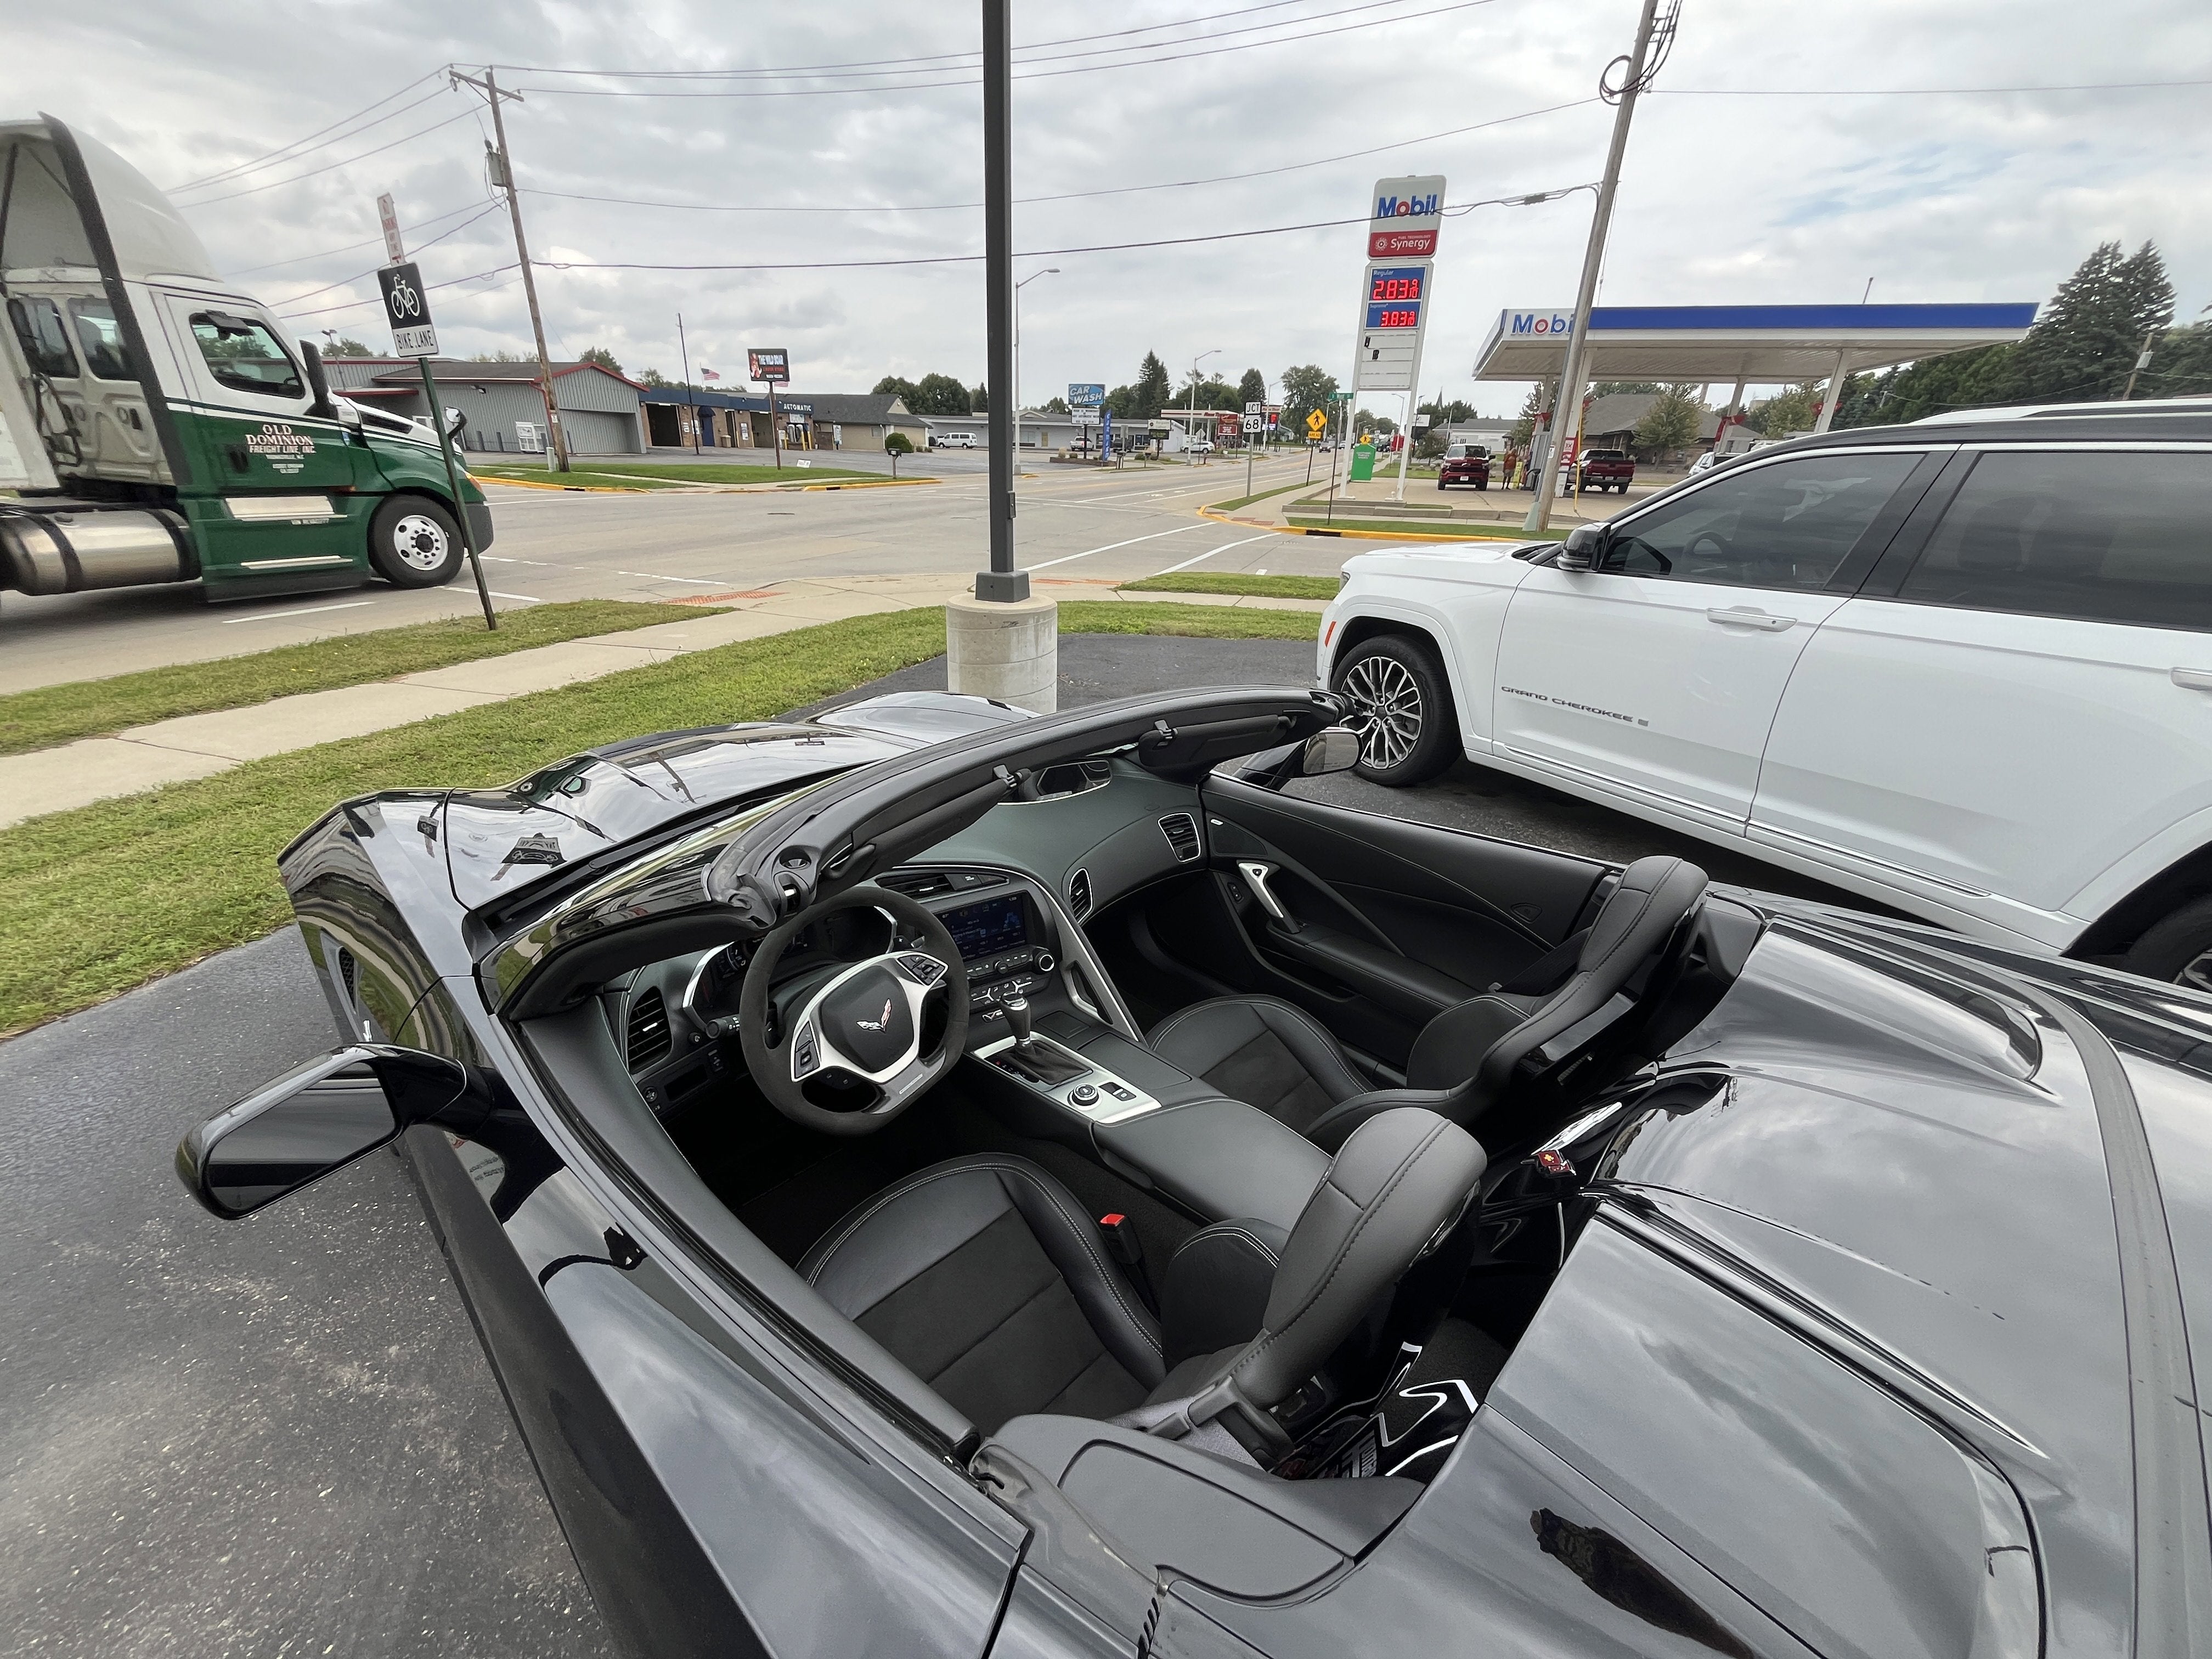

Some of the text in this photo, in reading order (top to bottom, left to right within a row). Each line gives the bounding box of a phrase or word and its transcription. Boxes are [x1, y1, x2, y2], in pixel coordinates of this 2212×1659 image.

[1378, 194, 1437, 218] Mobil
[1390, 239, 1431, 251] Synergy
[1511, 314, 1575, 334] Mobi
[396, 330, 434, 349] BIKE LANE
[1070, 386, 1091, 396] CAR
[1074, 392, 1103, 404] WASH
[783, 403, 812, 411] AUTOMATIC
[1247, 404, 1260, 413] JCT
[262, 424, 292, 435] OLD
[1245, 419, 1259, 430] 68
[245, 434, 314, 445] DOMINION
[249, 445, 281, 453] FREIGHT
[1501, 685, 1548, 701] GRAND
[1551, 697, 1634, 723] CHEROKEE
